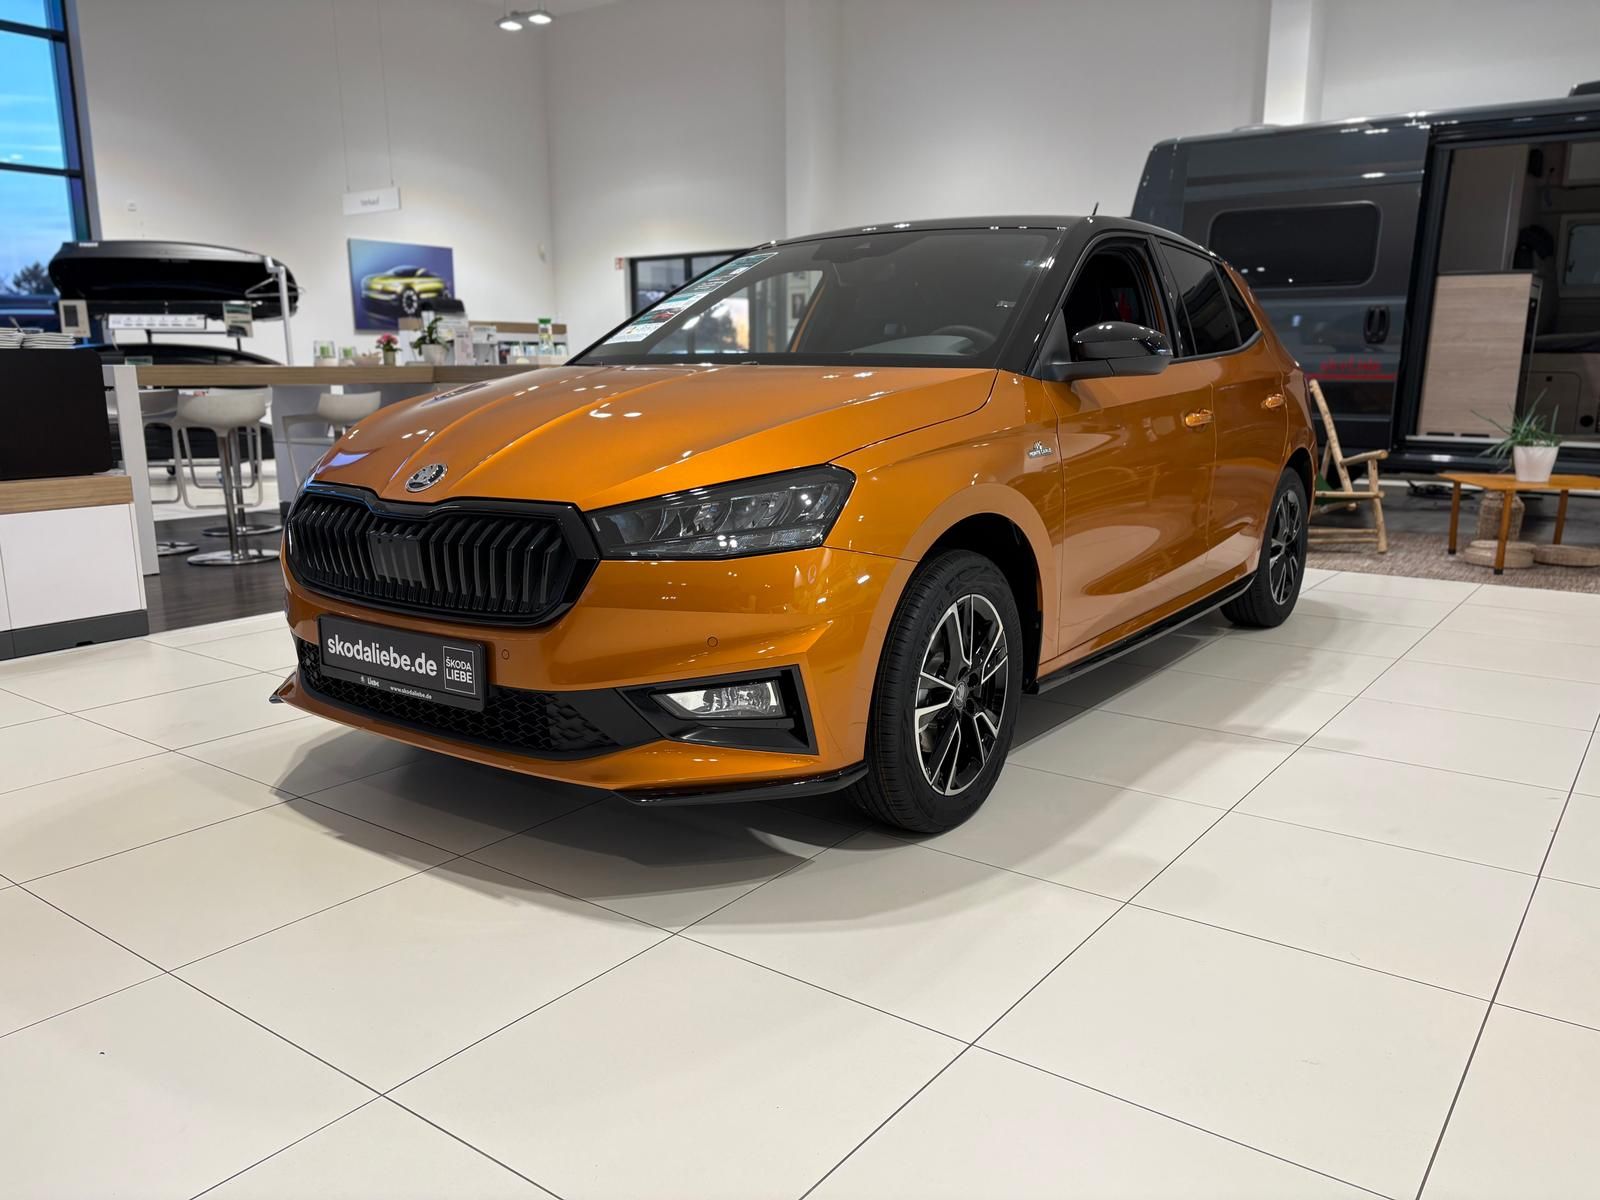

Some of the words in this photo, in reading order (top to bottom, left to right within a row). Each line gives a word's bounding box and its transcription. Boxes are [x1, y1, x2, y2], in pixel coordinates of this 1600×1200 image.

[327, 633, 438, 677] skodaliebe.de
[445, 656, 472, 671] ŠKODA
[445, 668, 473, 684] LIEBE
[389, 686, 433, 700] www.skodaliebe.de
